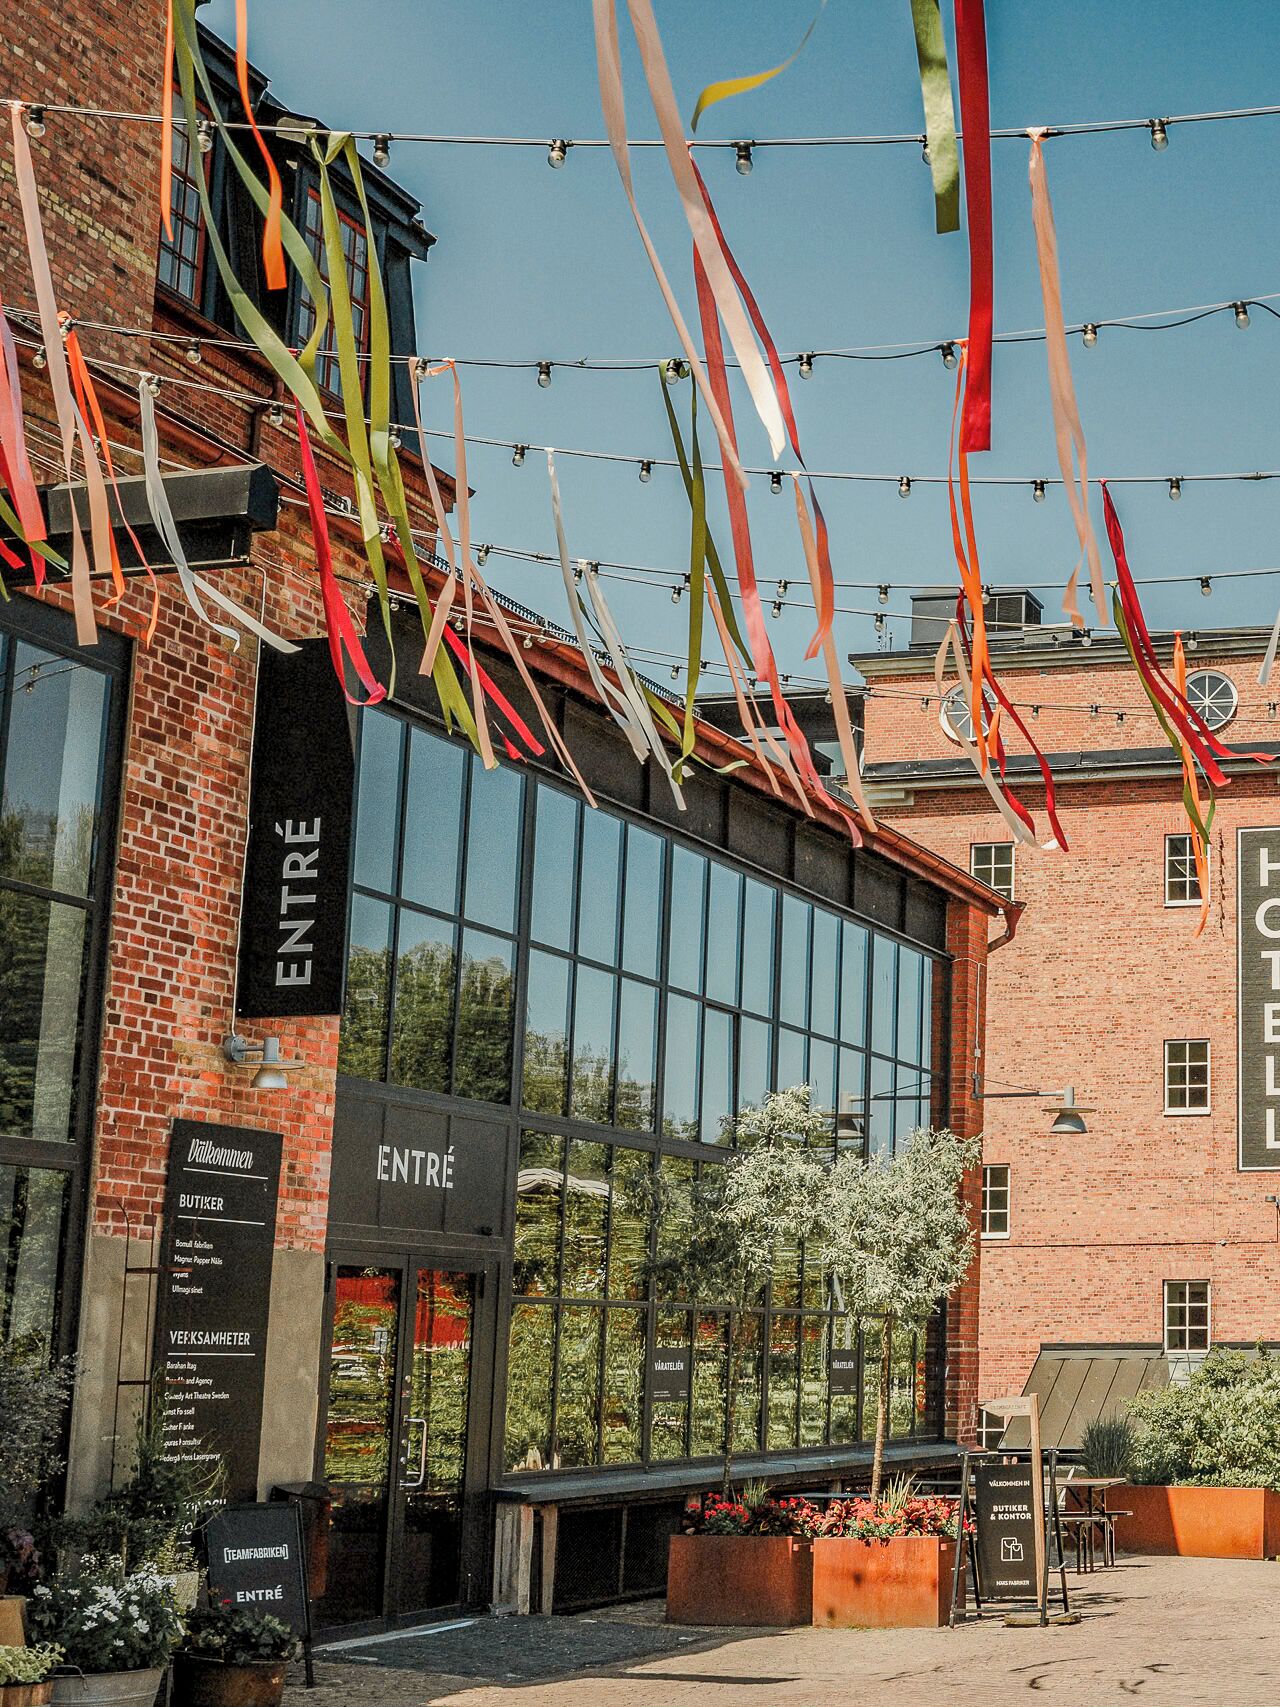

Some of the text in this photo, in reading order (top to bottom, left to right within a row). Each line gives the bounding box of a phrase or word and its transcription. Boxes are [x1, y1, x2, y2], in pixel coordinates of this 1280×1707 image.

[275, 816, 322, 987] ENTRÉ
[187, 1138, 254, 1169] Välkommen
[377, 1145, 455, 1189] ENTRÉ
[179, 1193, 224, 1211] BUTIKER
[169, 1330, 251, 1346] VERKSAMHETER
[211, 1391, 230, 1401] Sweden
[989, 1512, 1032, 1521] & KONTOR
[992, 1504, 1029, 1512] BUTIKER
[236, 1584, 284, 1603] ENTRÉ
